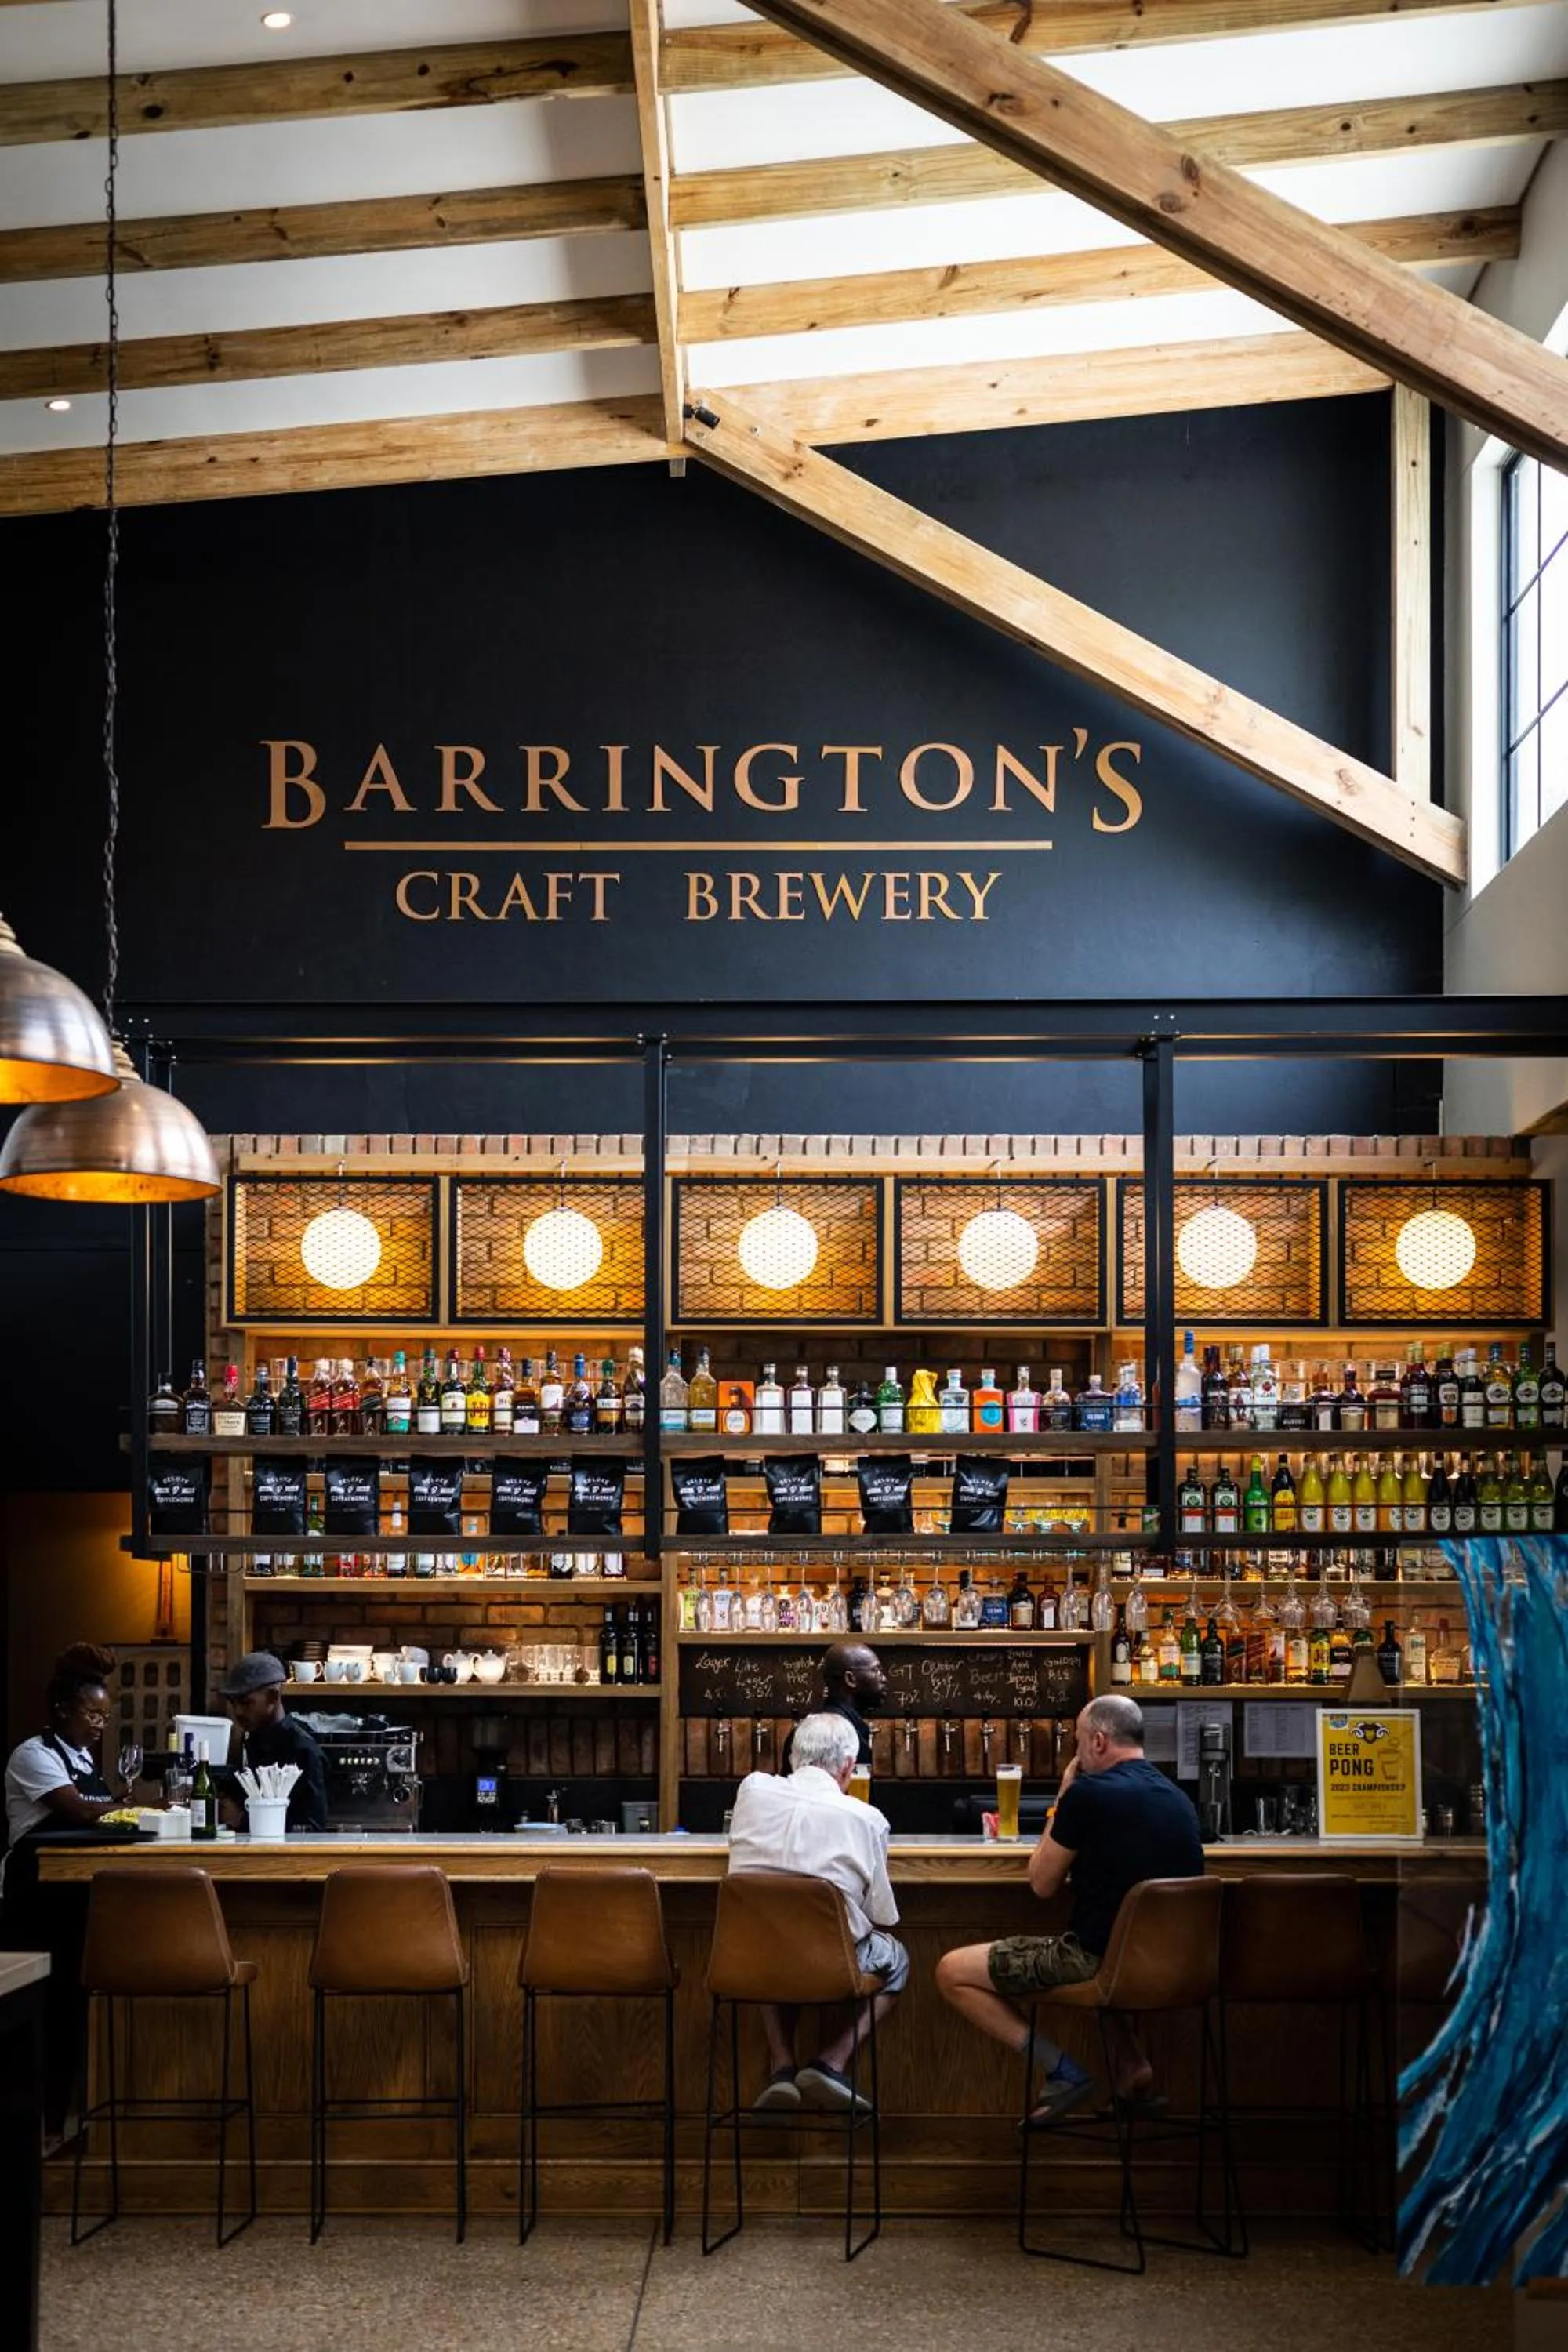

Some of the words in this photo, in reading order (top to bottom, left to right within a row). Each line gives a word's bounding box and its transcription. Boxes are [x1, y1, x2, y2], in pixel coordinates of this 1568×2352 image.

[259, 728, 1143, 833] BARRINGTON'S
[394, 871, 621, 921] CRAFT
[683, 871, 1003, 921] BREWERY
[695, 1651, 731, 1674] Lager
[1330, 1743, 1360, 1755] BEER
[1330, 1759, 1374, 1776] PONG
